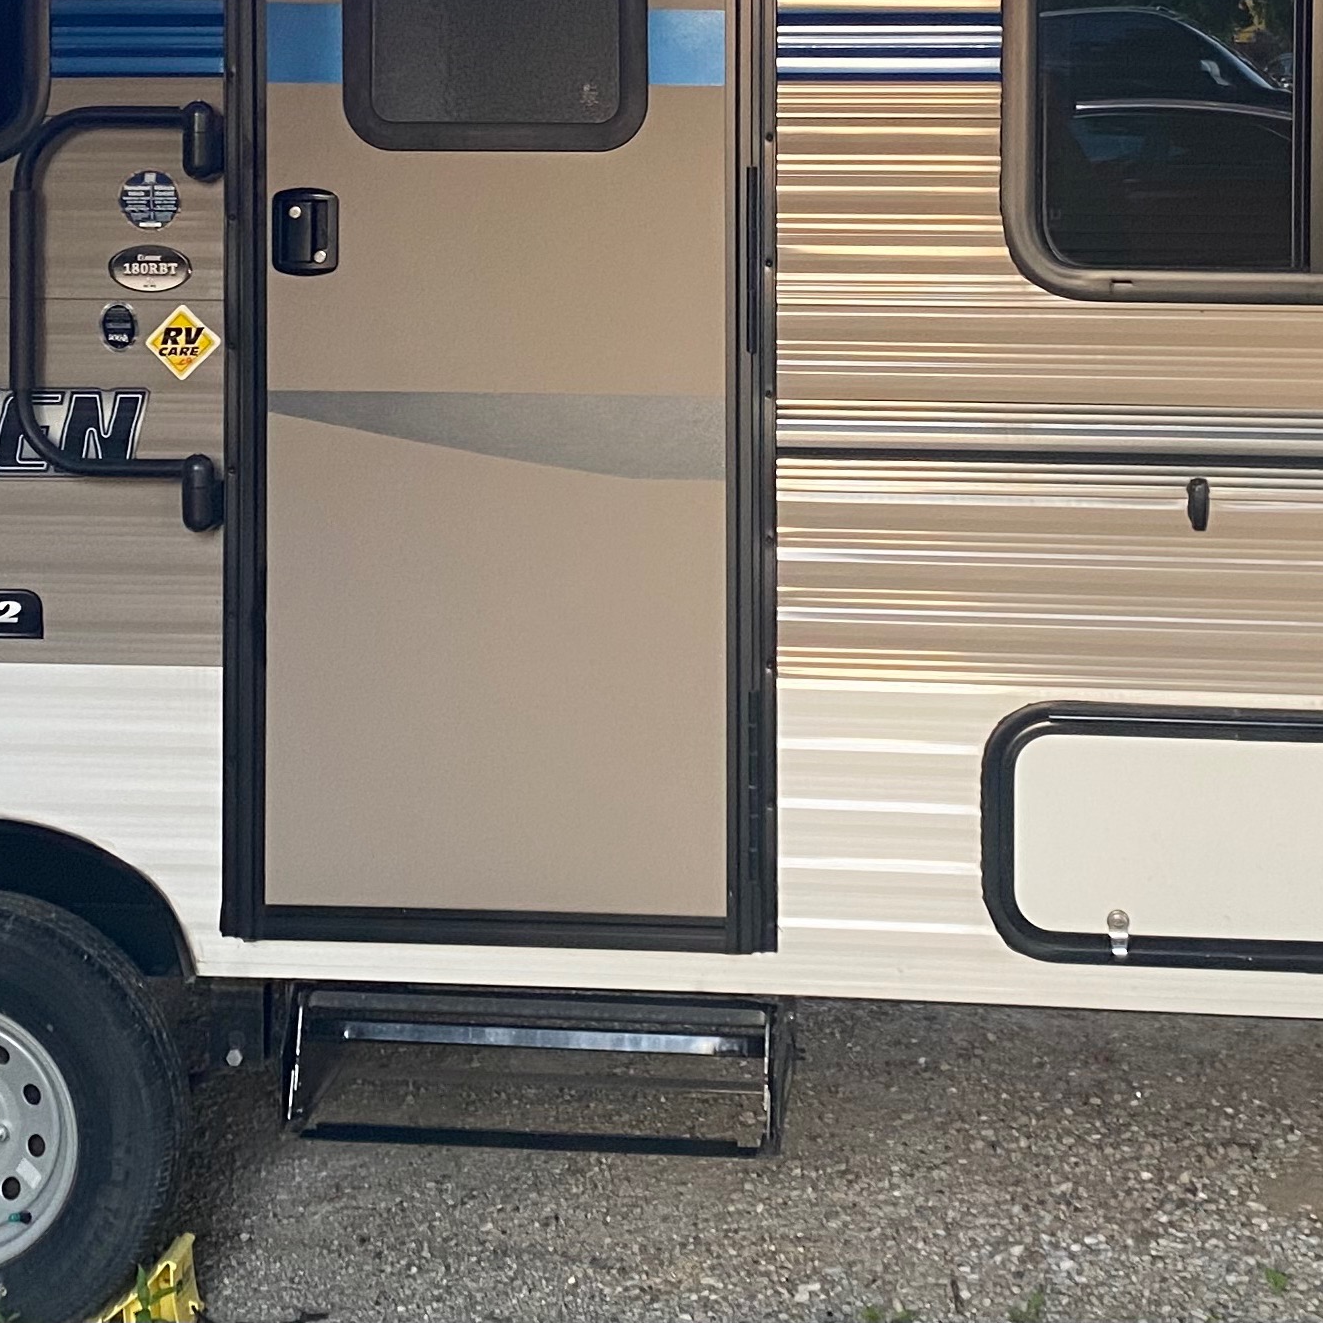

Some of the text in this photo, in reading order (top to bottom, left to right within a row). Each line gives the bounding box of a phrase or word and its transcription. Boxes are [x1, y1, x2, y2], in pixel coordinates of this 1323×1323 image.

[123, 262, 179, 276] 180RBT
[161, 327, 205, 346] RV
[158, 347, 200, 357] CARE
